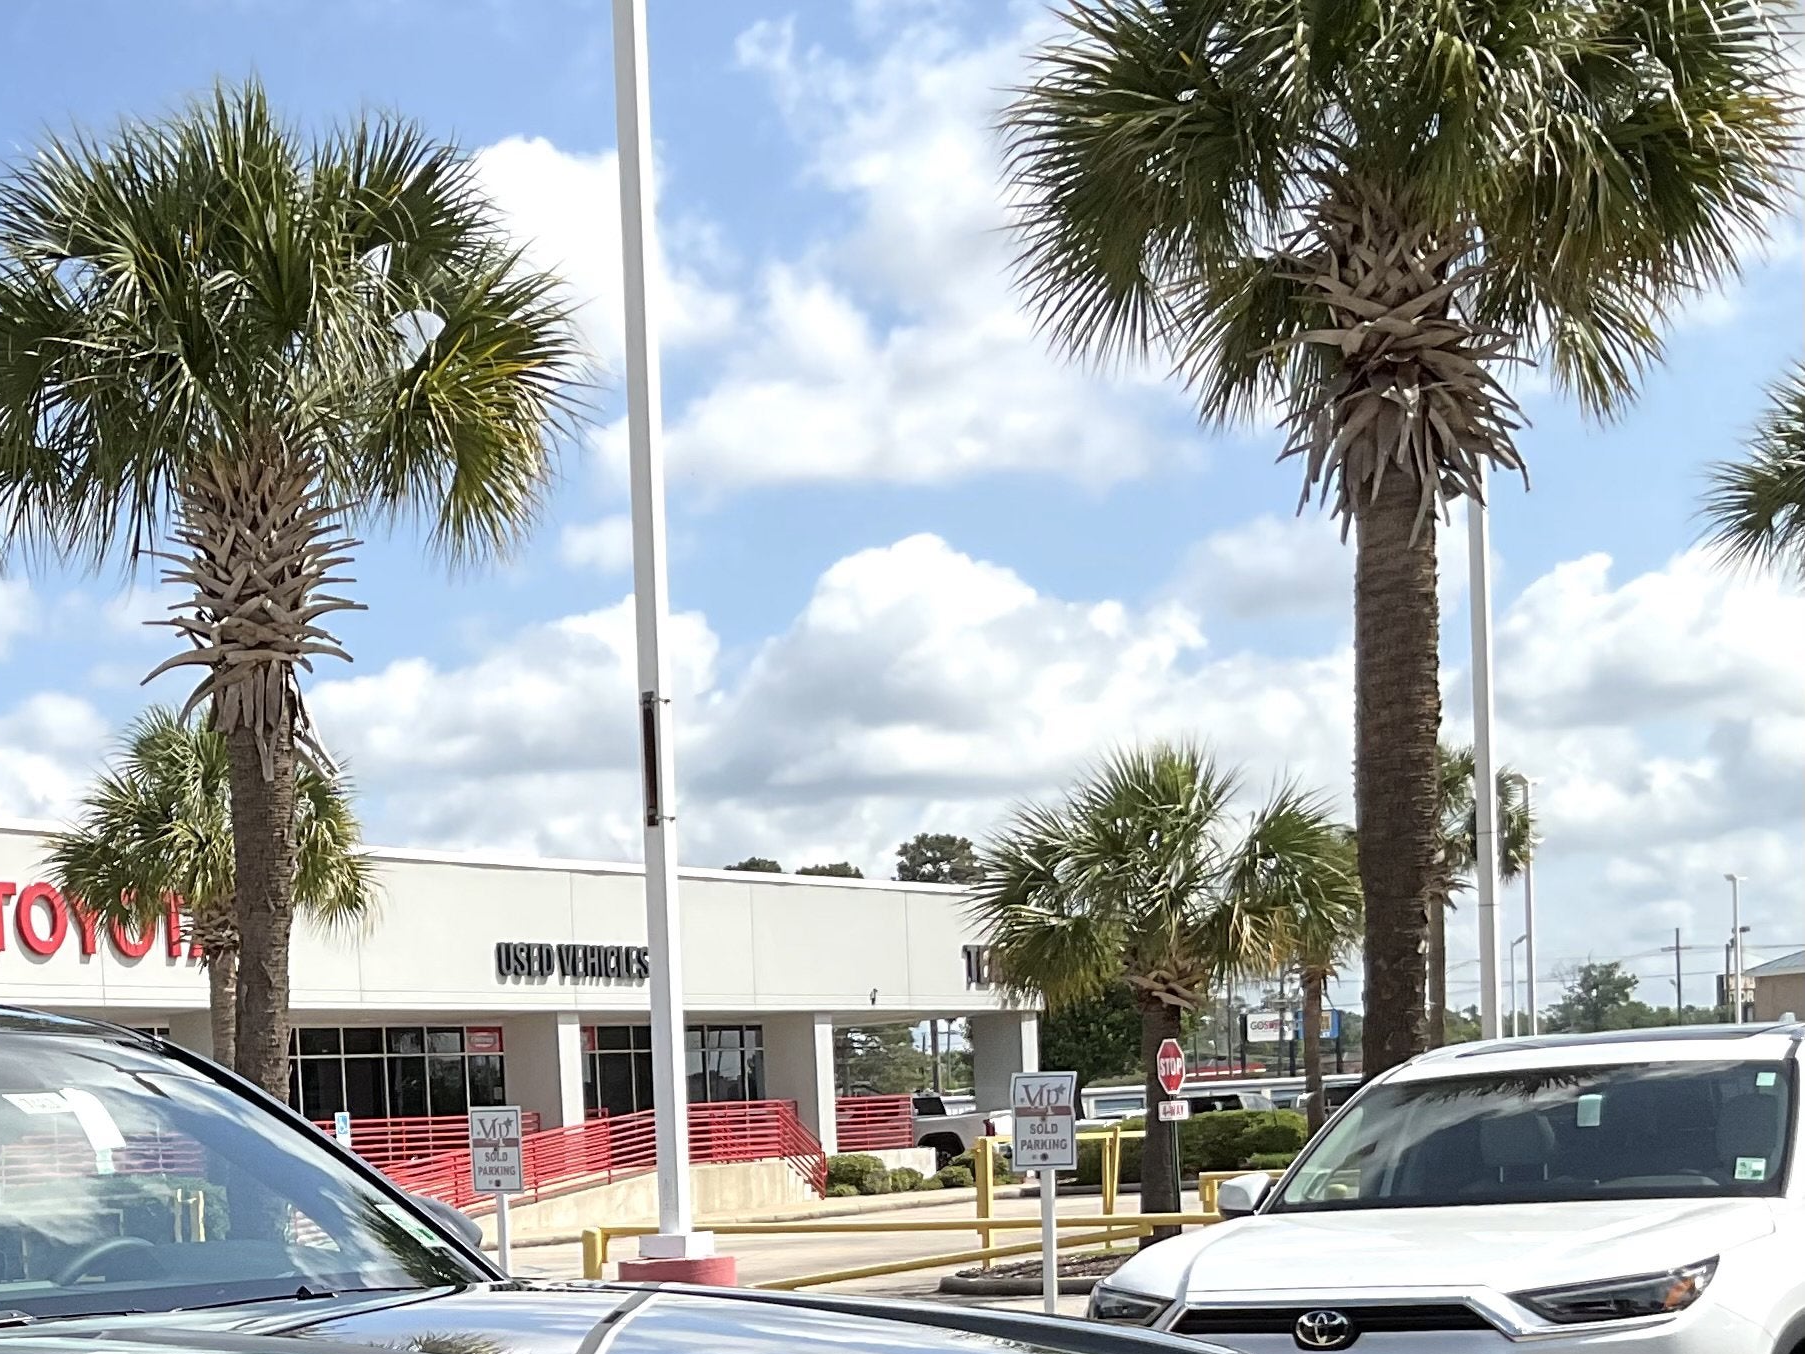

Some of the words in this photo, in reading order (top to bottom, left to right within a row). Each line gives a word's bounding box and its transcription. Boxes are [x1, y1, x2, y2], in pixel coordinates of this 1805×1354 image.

[494, 942, 555, 976] USED
[556, 944, 650, 978] VEHICLES
[1159, 1057, 1183, 1077] STOP
[1029, 1123, 1059, 1134] SOLD
[1020, 1138, 1068, 1151] PARKING
[484, 1151, 508, 1162] SOLD
[477, 1165, 516, 1176] PARKING
